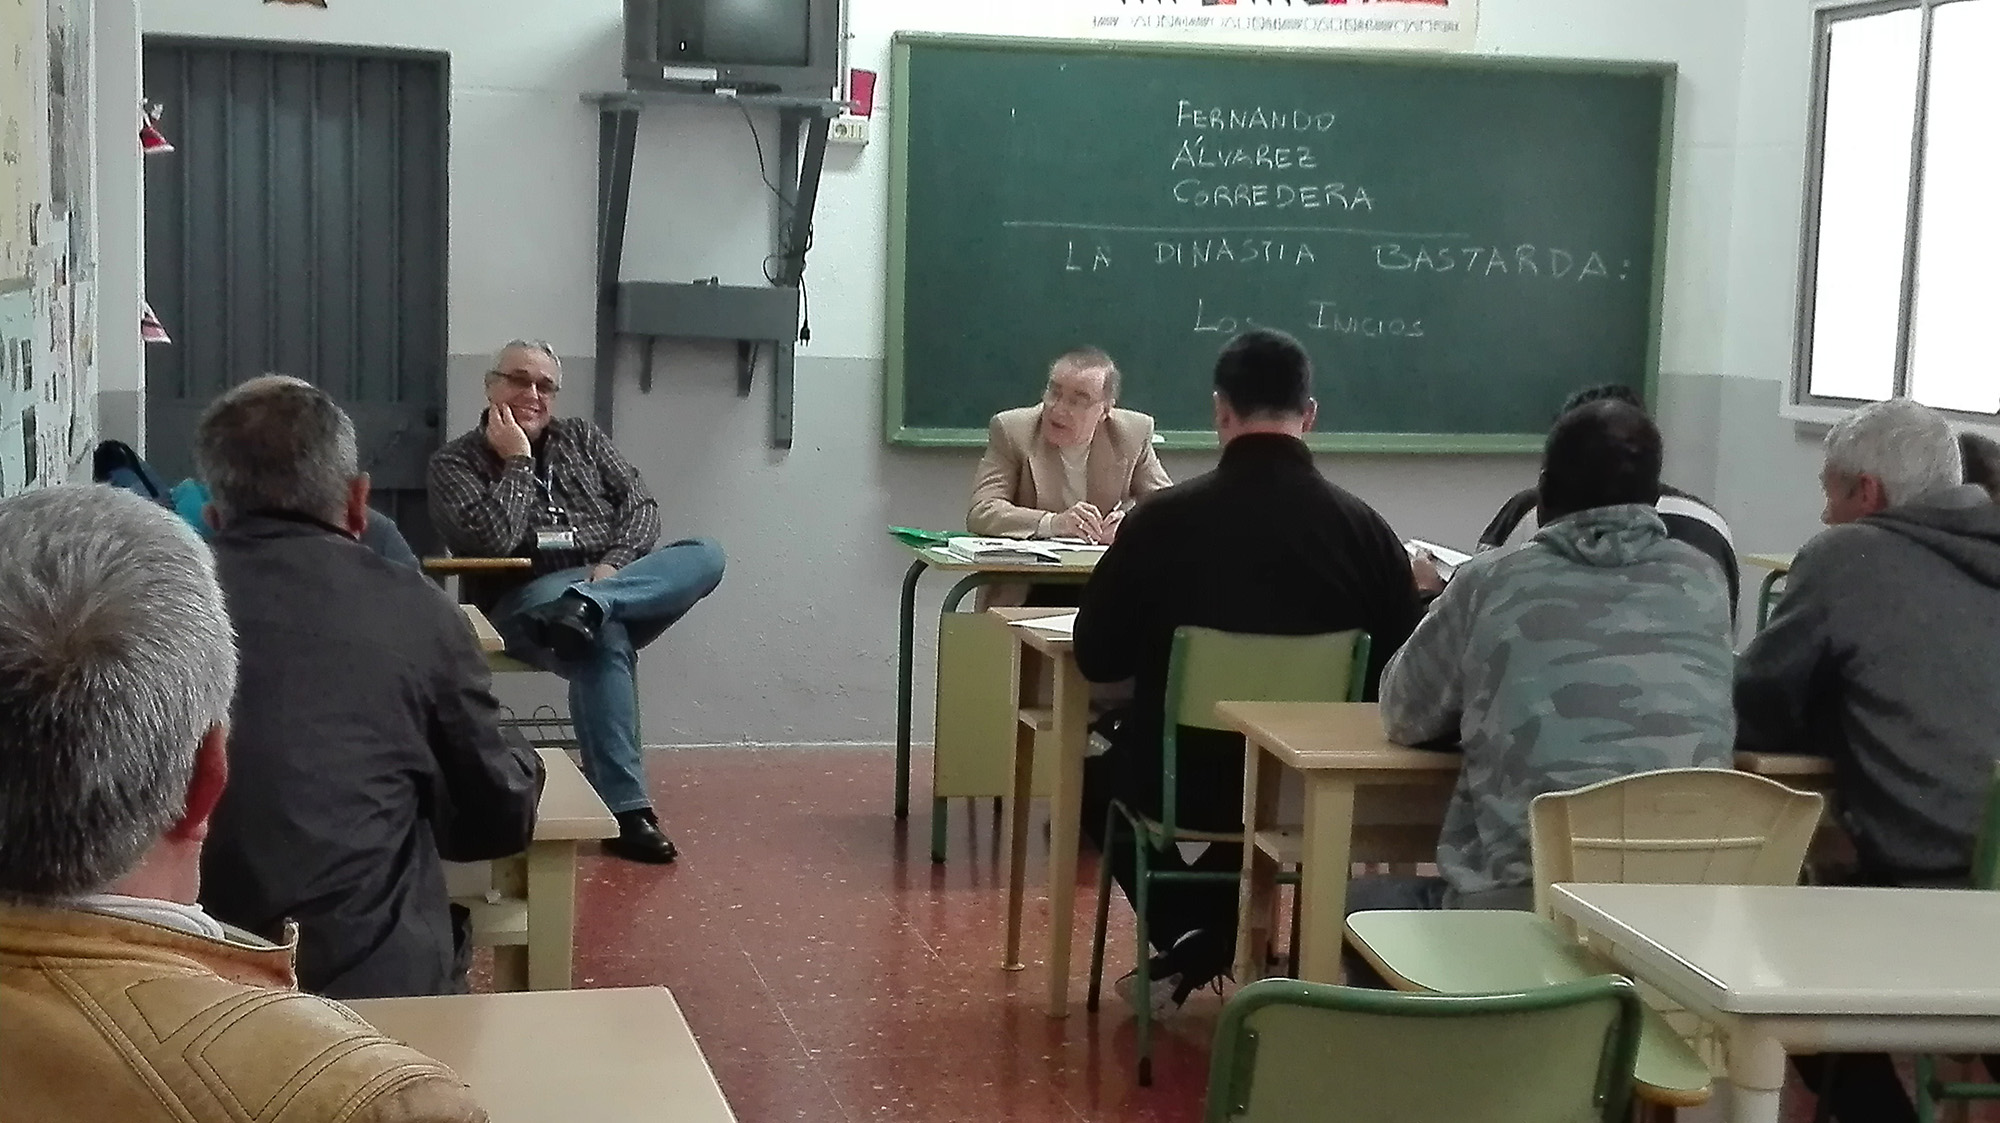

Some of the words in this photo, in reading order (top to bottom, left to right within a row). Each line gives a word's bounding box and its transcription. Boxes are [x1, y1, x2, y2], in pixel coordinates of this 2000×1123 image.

[1177, 99, 1335, 131] FERNANDO
[1171, 135, 1317, 170] ÁLVAREZ
[1173, 178, 1373, 210] CORREDERA
[1066, 241, 1111, 272] LA
[1374, 243, 1631, 281] BASTARDA:
[1308, 302, 1424, 337] INICIOS
